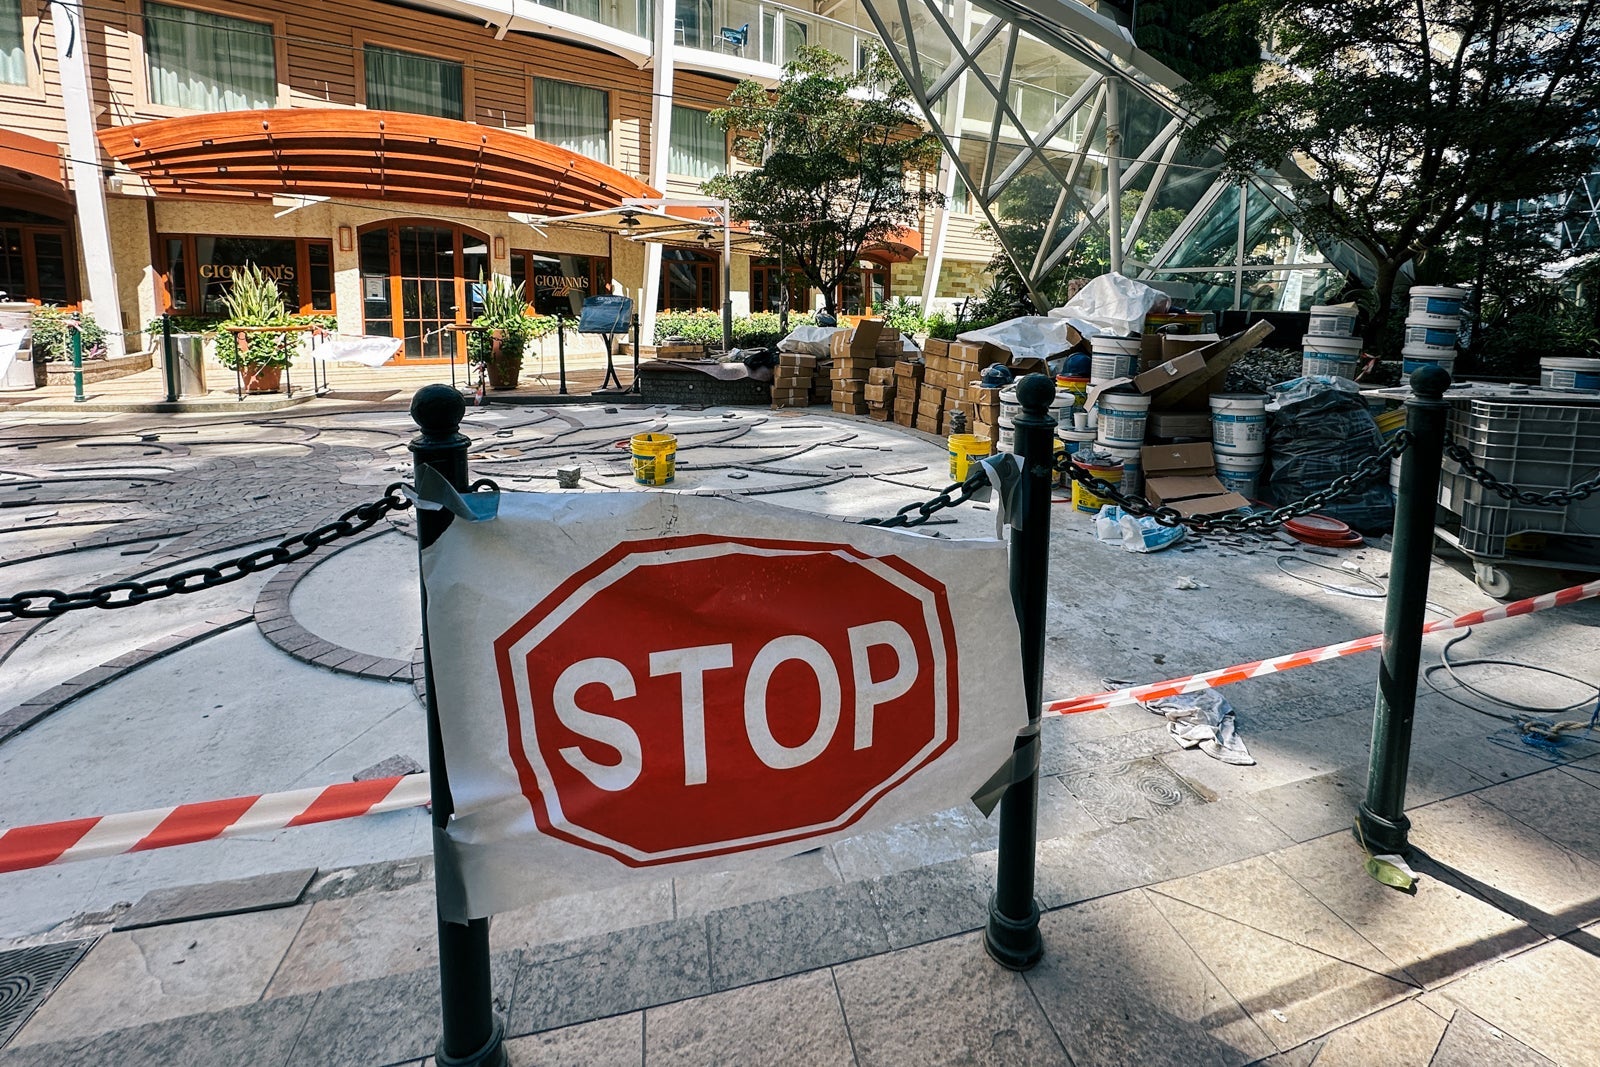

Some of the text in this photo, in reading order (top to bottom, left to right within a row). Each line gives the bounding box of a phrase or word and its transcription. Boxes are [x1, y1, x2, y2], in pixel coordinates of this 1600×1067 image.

[199, 263, 294, 280] GIOVNI'S
[535, 274, 589, 289] GIOVANNI'S
[553, 620, 919, 791] STOP
